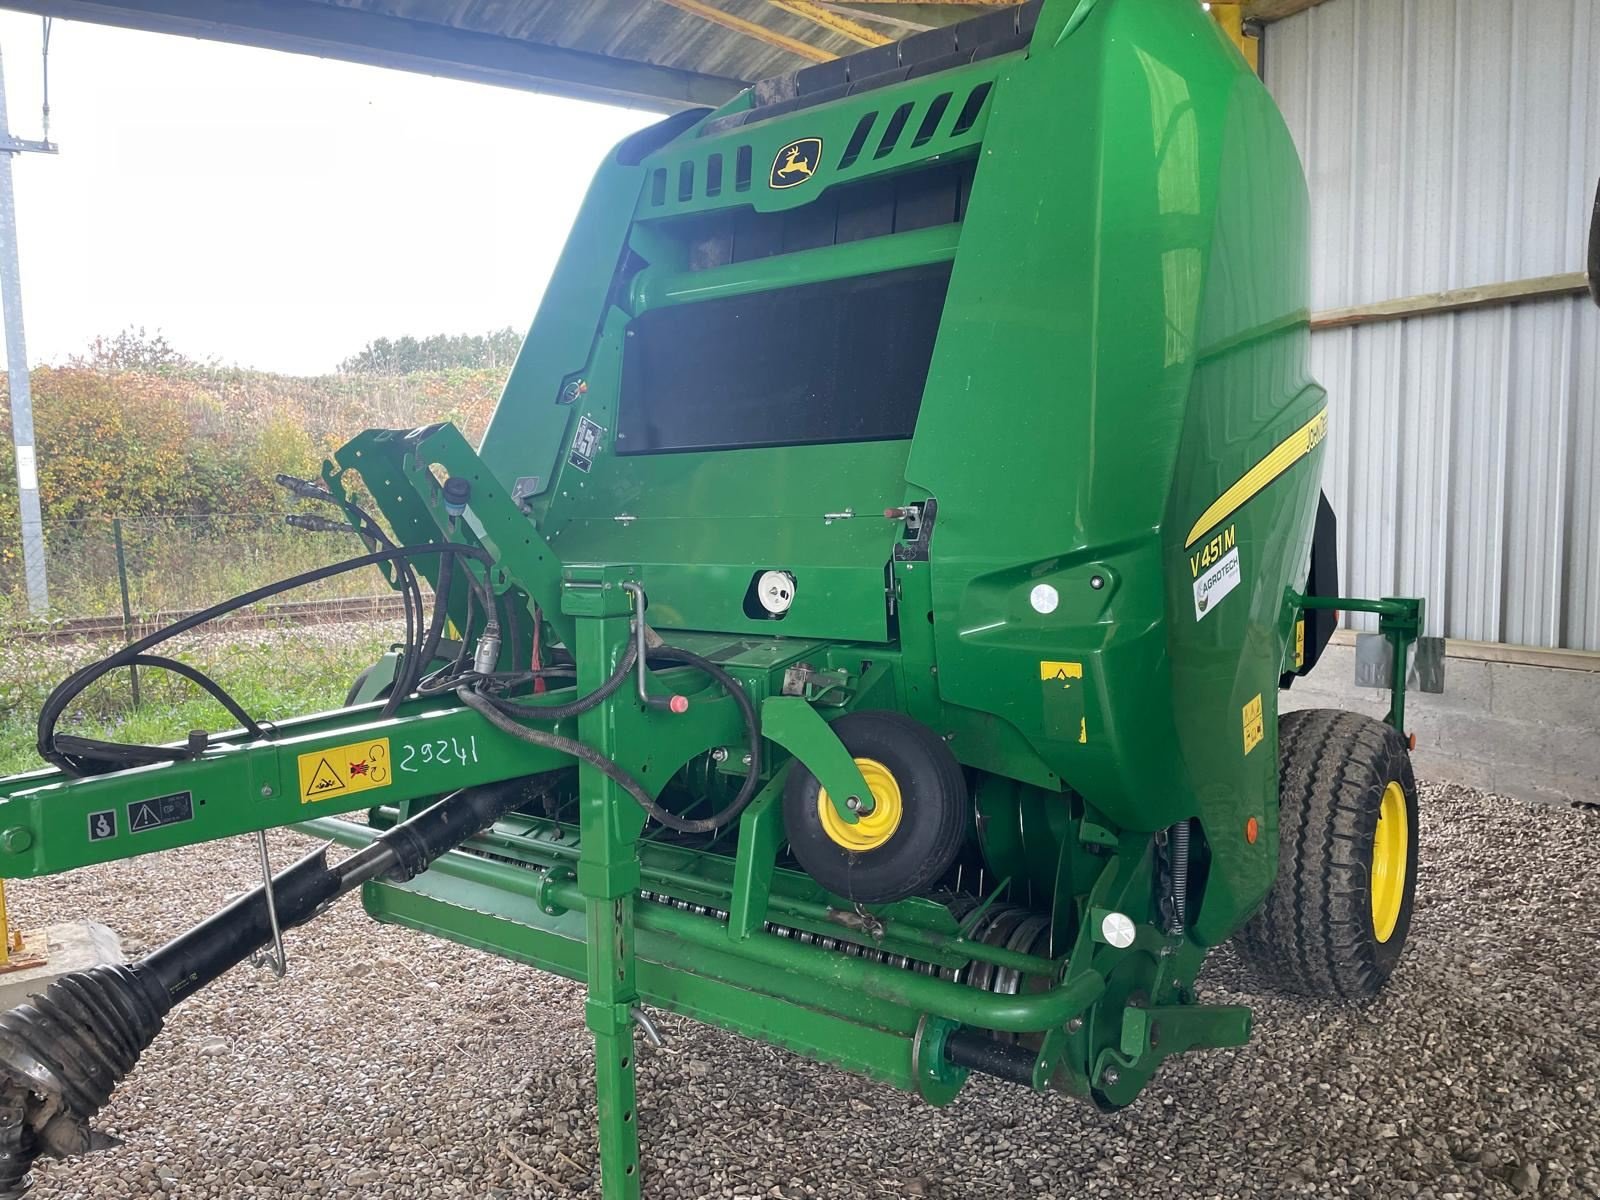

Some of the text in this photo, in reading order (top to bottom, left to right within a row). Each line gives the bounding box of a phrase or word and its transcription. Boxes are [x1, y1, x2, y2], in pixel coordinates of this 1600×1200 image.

[1190, 552, 1200, 578] V
[1201, 534, 1222, 567] 451
[1224, 523, 1235, 551] M
[1203, 556, 1238, 594] AGROTECH
[400, 735, 478, 773] 29241
